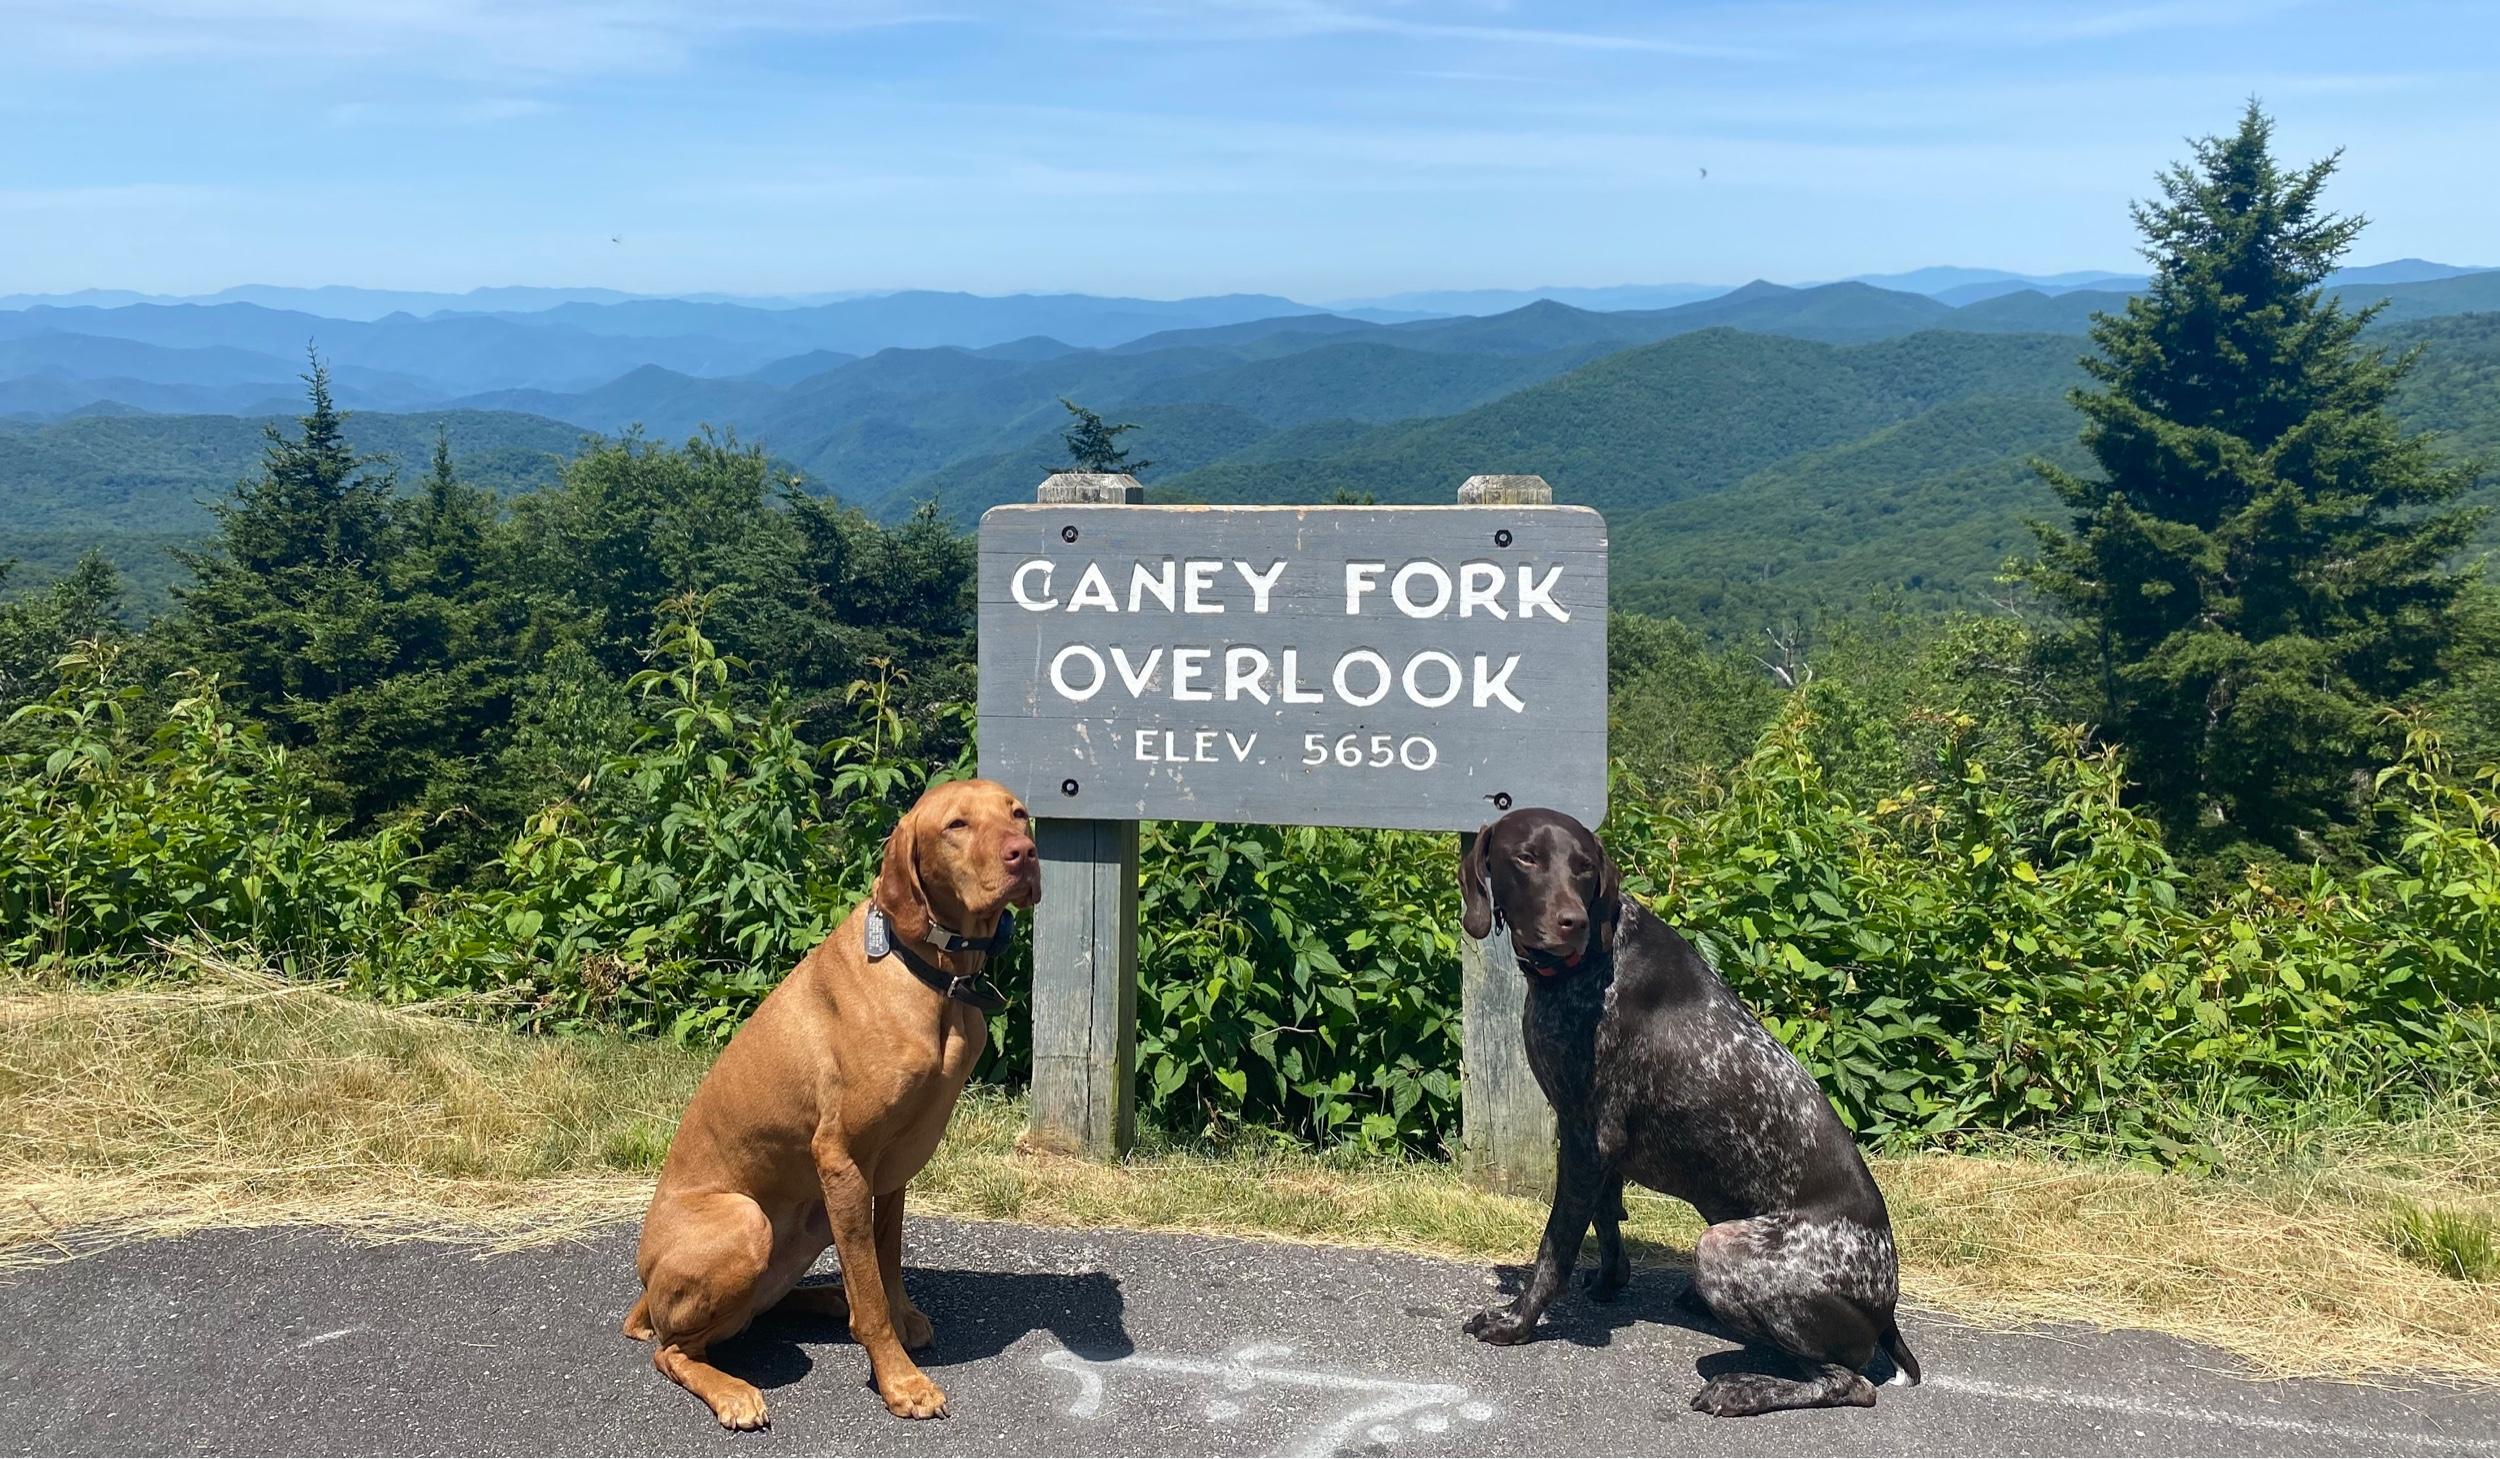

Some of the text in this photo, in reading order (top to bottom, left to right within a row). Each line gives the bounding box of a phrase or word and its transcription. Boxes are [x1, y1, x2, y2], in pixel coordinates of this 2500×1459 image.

[1010, 558, 1572, 623] CANEY FORK
[1049, 645, 1526, 713] OVERLOOK
[1135, 729, 1438, 771] ELEV. 5650
